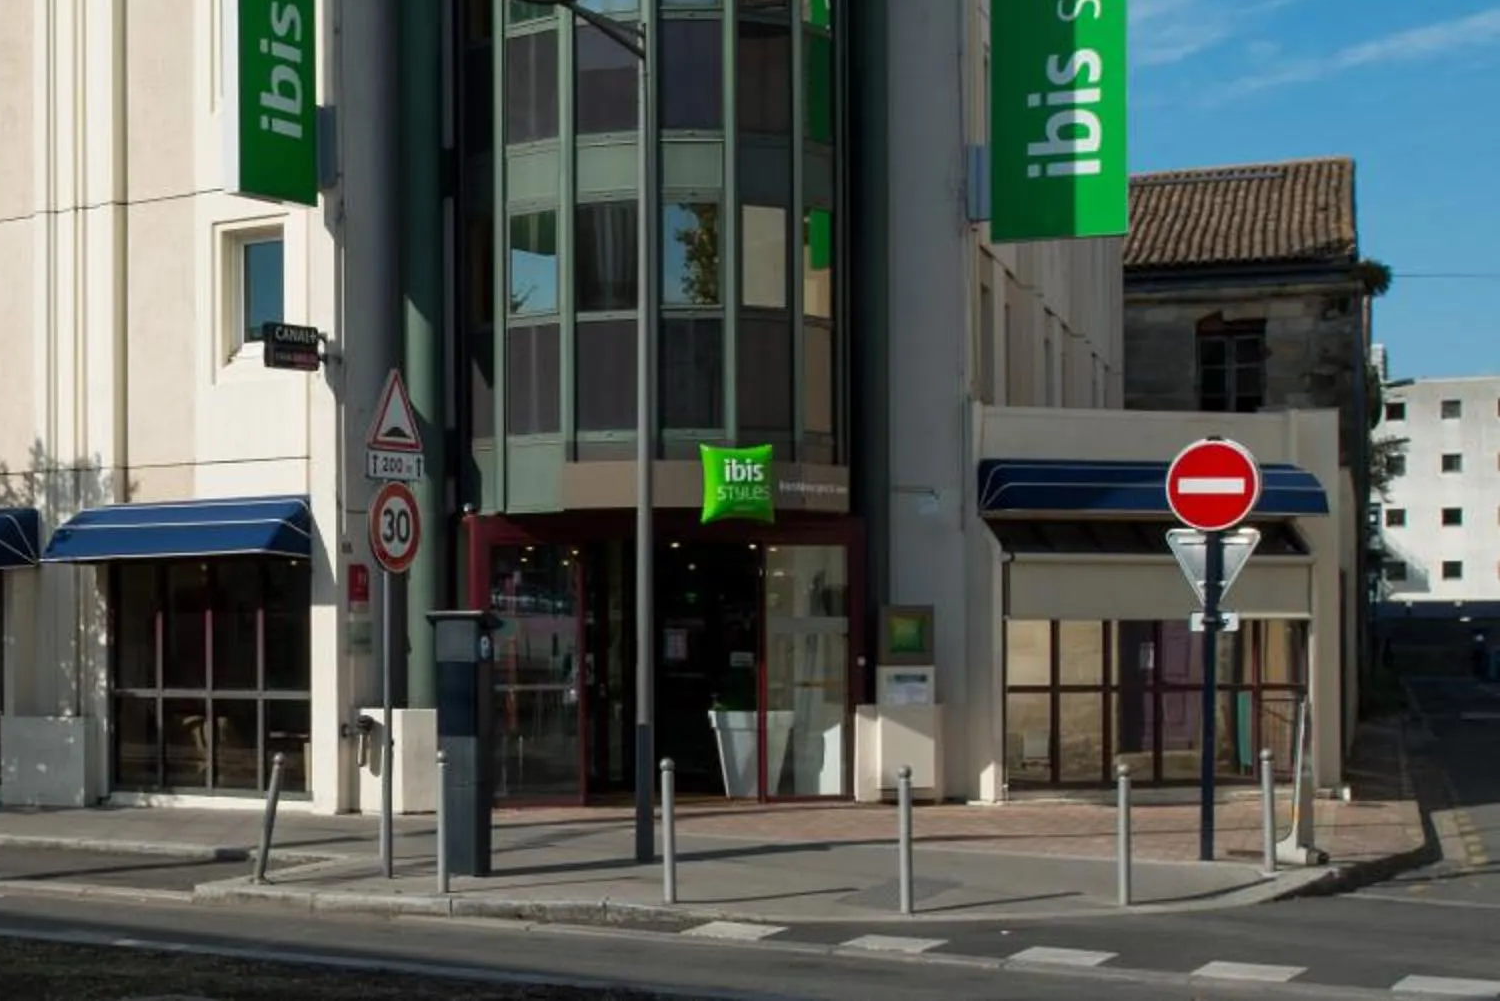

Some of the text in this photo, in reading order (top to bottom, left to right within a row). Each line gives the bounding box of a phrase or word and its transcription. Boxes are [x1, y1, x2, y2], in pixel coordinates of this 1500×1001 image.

[260, 0, 303, 139] ibis
[1027, 47, 1101, 178] ibis
[382, 456, 403, 473] 200
[723, 458, 764, 482] ibis
[382, 508, 411, 543] 30
